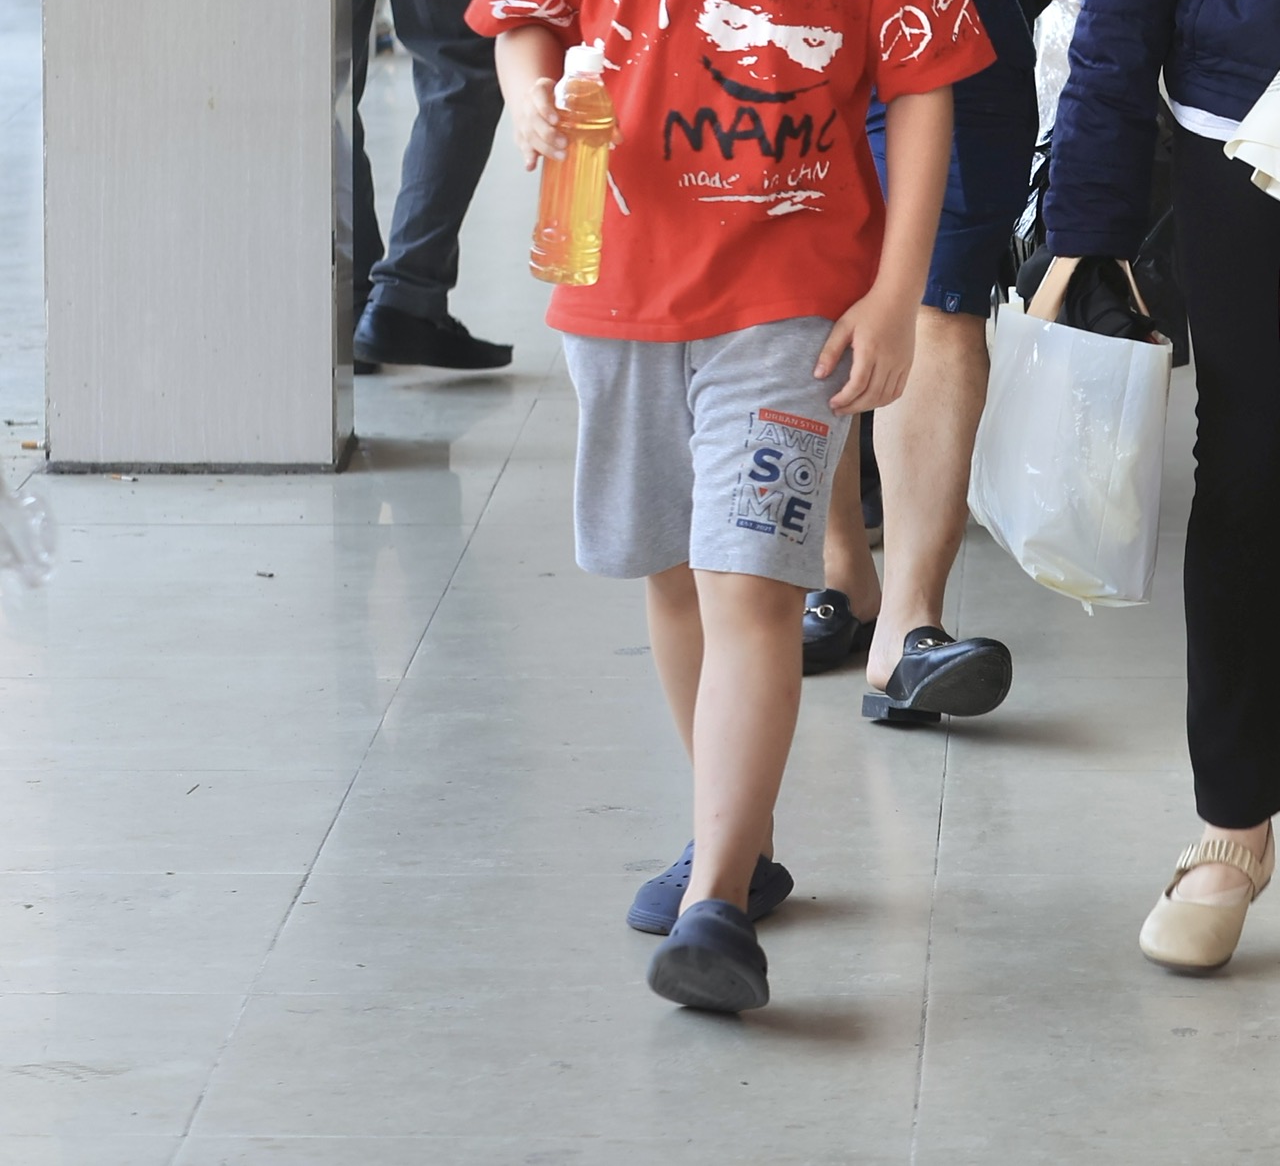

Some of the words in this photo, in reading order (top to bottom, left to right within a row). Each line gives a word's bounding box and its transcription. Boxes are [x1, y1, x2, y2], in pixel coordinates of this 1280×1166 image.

[764, 411, 799, 426] URBAN
[799, 419, 824, 433] STYLE
[755, 422, 828, 460] AWE
